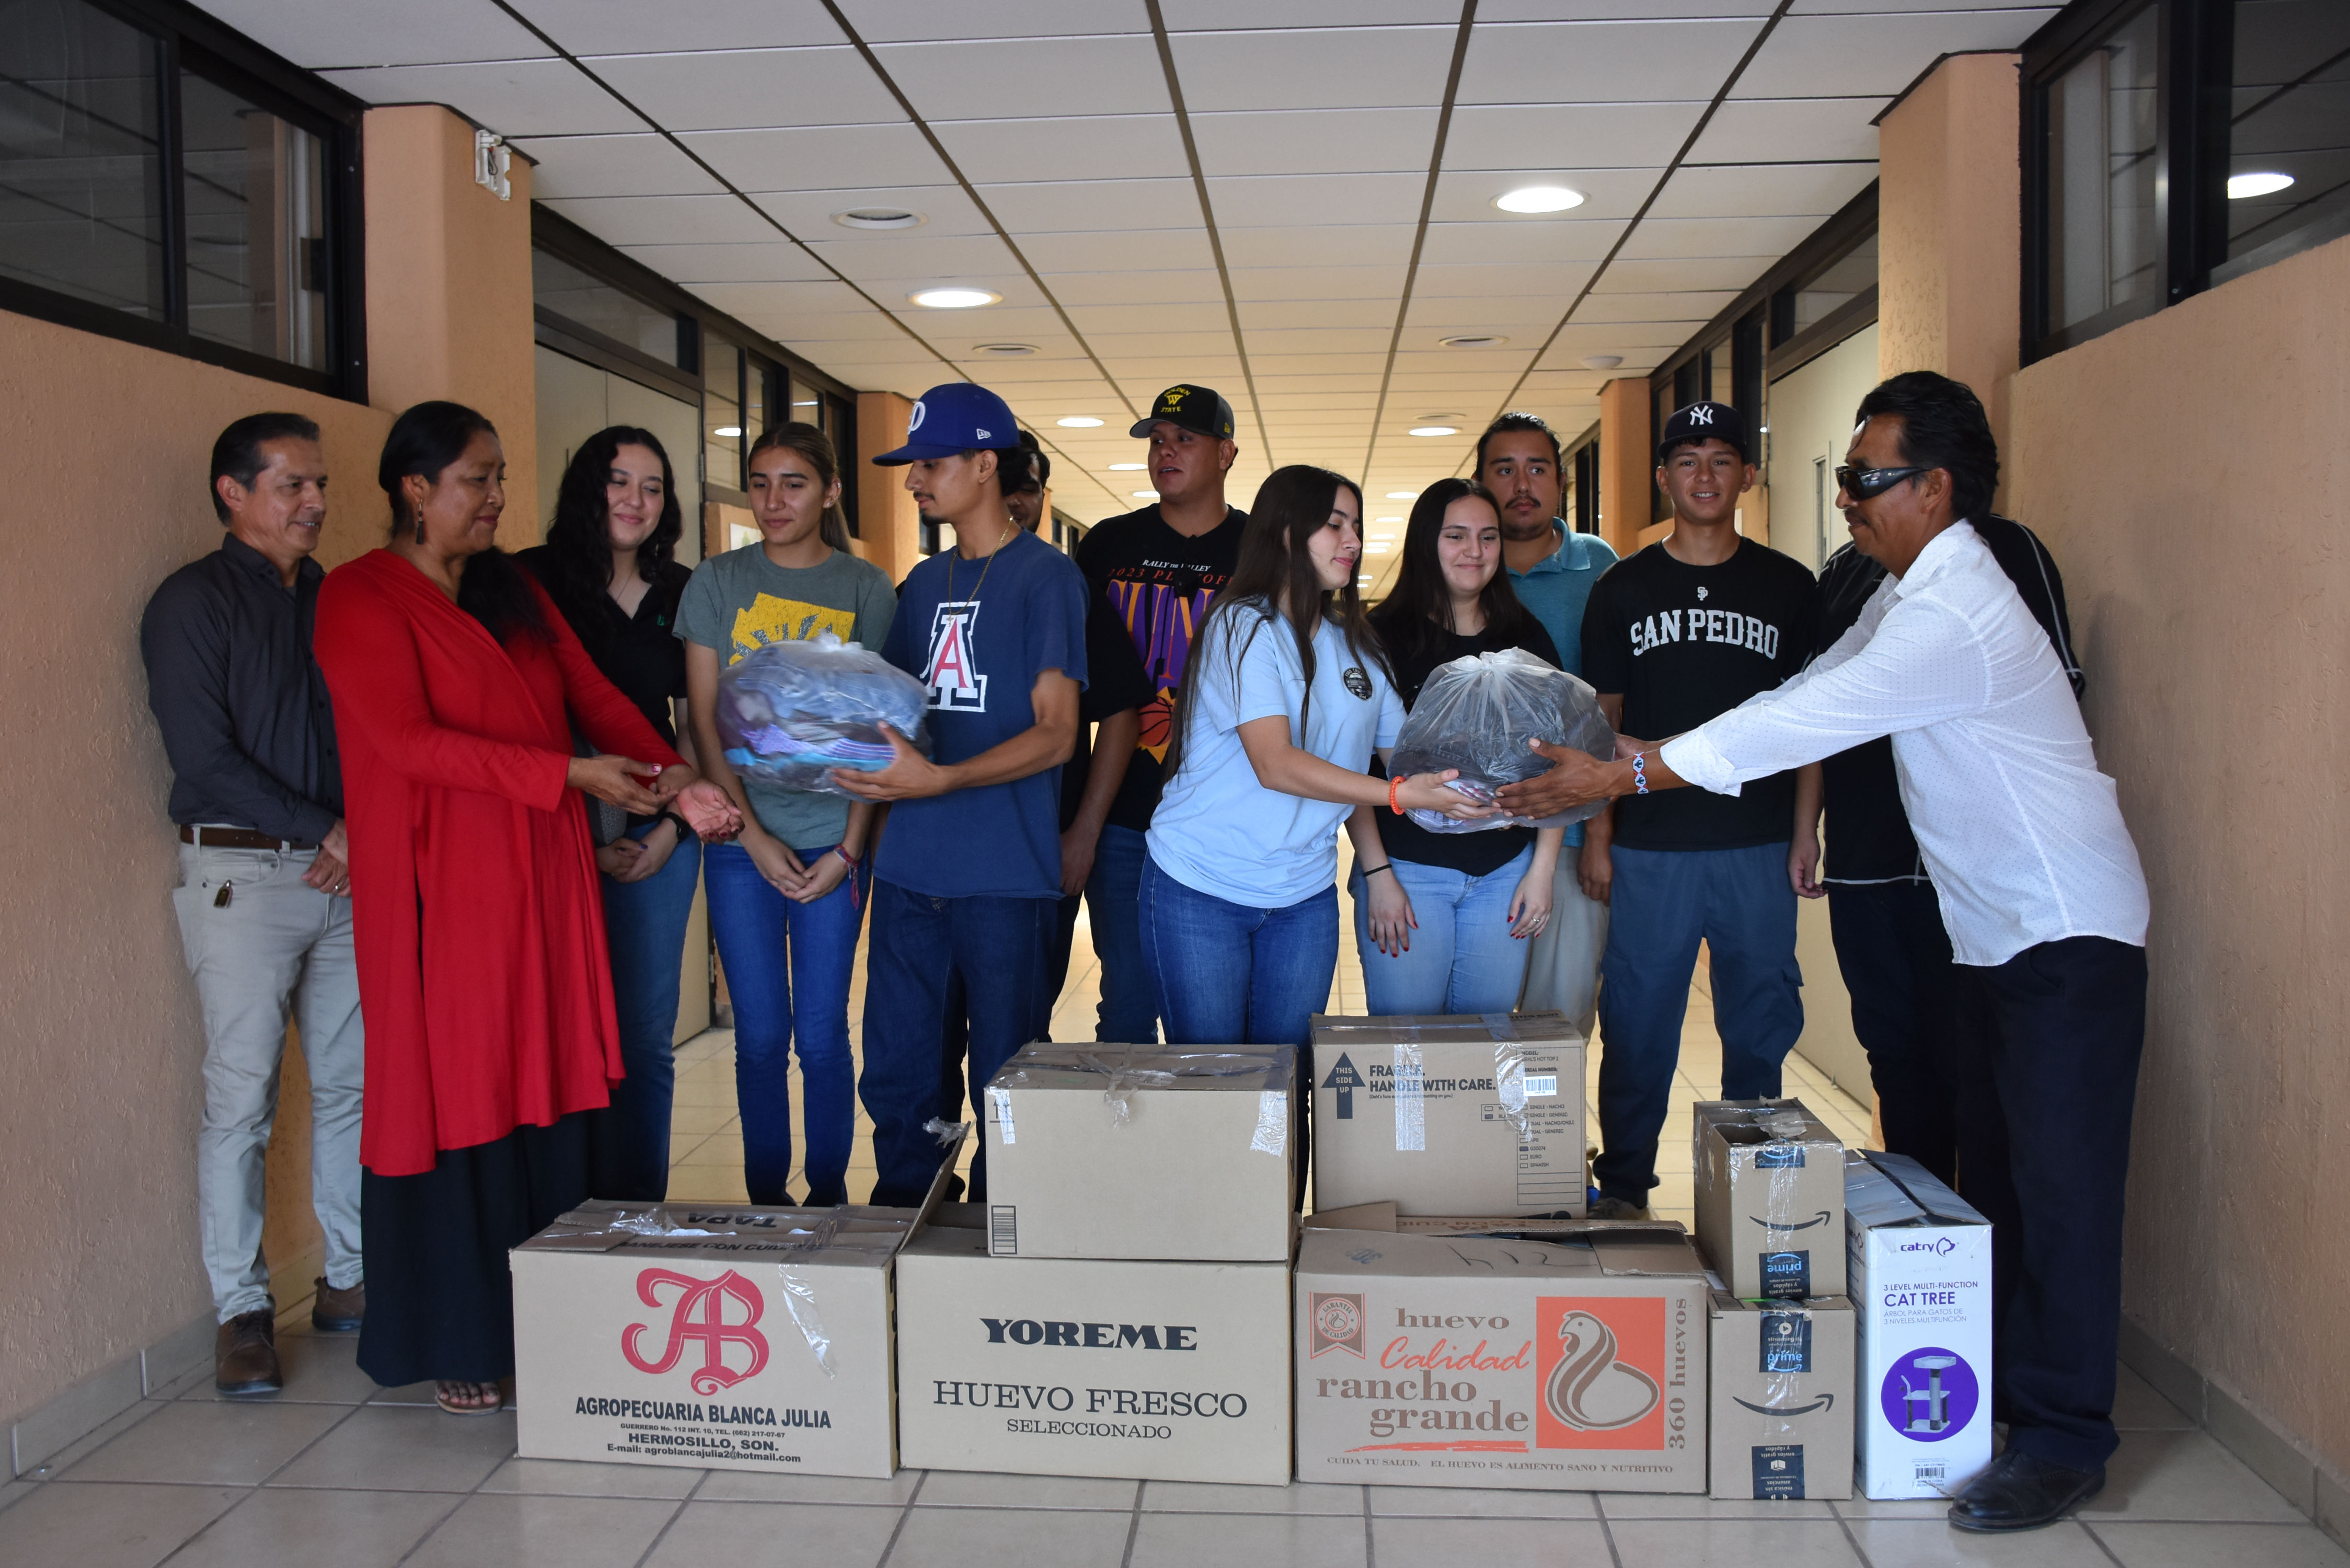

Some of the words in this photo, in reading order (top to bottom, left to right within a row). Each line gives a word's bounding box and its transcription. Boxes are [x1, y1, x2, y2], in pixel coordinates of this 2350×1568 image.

[1164, 387, 1191, 396] GOLDEN
[1142, 559, 1170, 569] RALLY
[1630, 609, 1681, 656] SAN
[1688, 608, 1779, 660] PEDRO
[919, 601, 988, 713] A
[1370, 1080, 1420, 1092] HANDLE
[1423, 1079, 1456, 1091] WITH
[1458, 1078, 1496, 1091] CARE.
[688, 1213, 777, 1228] TAPA
[1900, 1242, 1934, 1252] catry
[1767, 1261, 1802, 1274] prime
[1913, 1281, 1978, 1289] MULTI-FUNCTION
[1884, 1293, 1917, 1307] CAT
[1921, 1292, 1955, 1305] TREE
[1395, 1308, 1510, 1329] huevo
[1917, 1315, 1966, 1323] MULTIFUNCIÓN
[980, 1318, 1197, 1351] YOREME
[1321, 1327, 1330, 1336] DE
[1330, 1328, 1354, 1339] CALIDAD
[1669, 1298, 1686, 1388] huevos
[1379, 1335, 1531, 1371] Calidad
[1768, 1352, 1802, 1363] prime
[1316, 1369, 1477, 1401] rancho
[933, 1380, 1074, 1411] HUEVO
[1086, 1388, 1248, 1418] FRESCO
[575, 1397, 704, 1422] AGROPECUARIA
[709, 1405, 777, 1425] BLANCA
[781, 1409, 831, 1428] JULIA
[1369, 1400, 1528, 1437] grande
[1007, 1419, 1172, 1439] SELECCIONADO
[1668, 1397, 1686, 1449] 360
[629, 1433, 735, 1450] HERMOSILLO,
[741, 1439, 779, 1451] SON.
[607, 1444, 641, 1453] E-mail:
[645, 1447, 801, 1462] agroblancajulia2@hotmail.com
